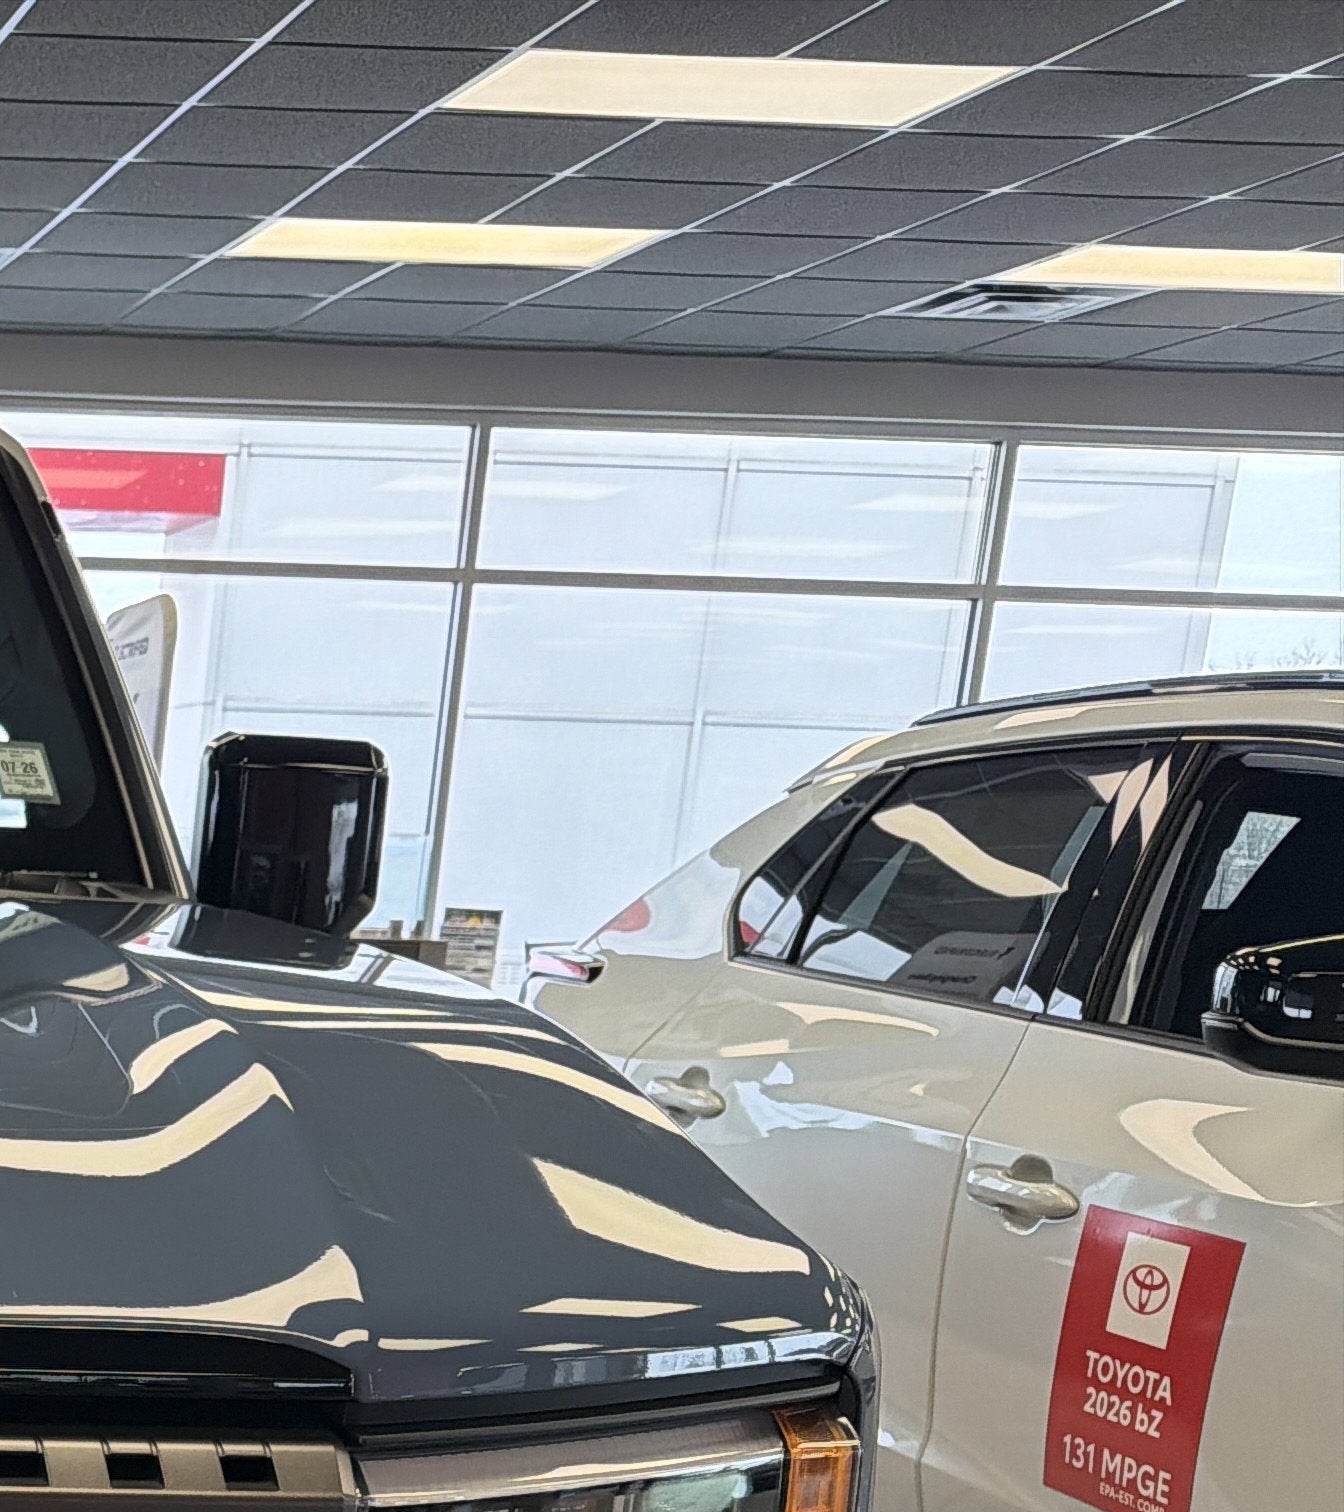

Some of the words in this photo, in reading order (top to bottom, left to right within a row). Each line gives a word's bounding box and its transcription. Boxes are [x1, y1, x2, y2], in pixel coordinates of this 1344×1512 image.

[1085, 1349, 1173, 1407] TOYOTA
[1083, 1386, 1132, 1428] 2026
[1134, 1402, 1165, 1439] bZ
[1062, 1433, 1097, 1475] 131
[1100, 1446, 1173, 1506] MPGE
